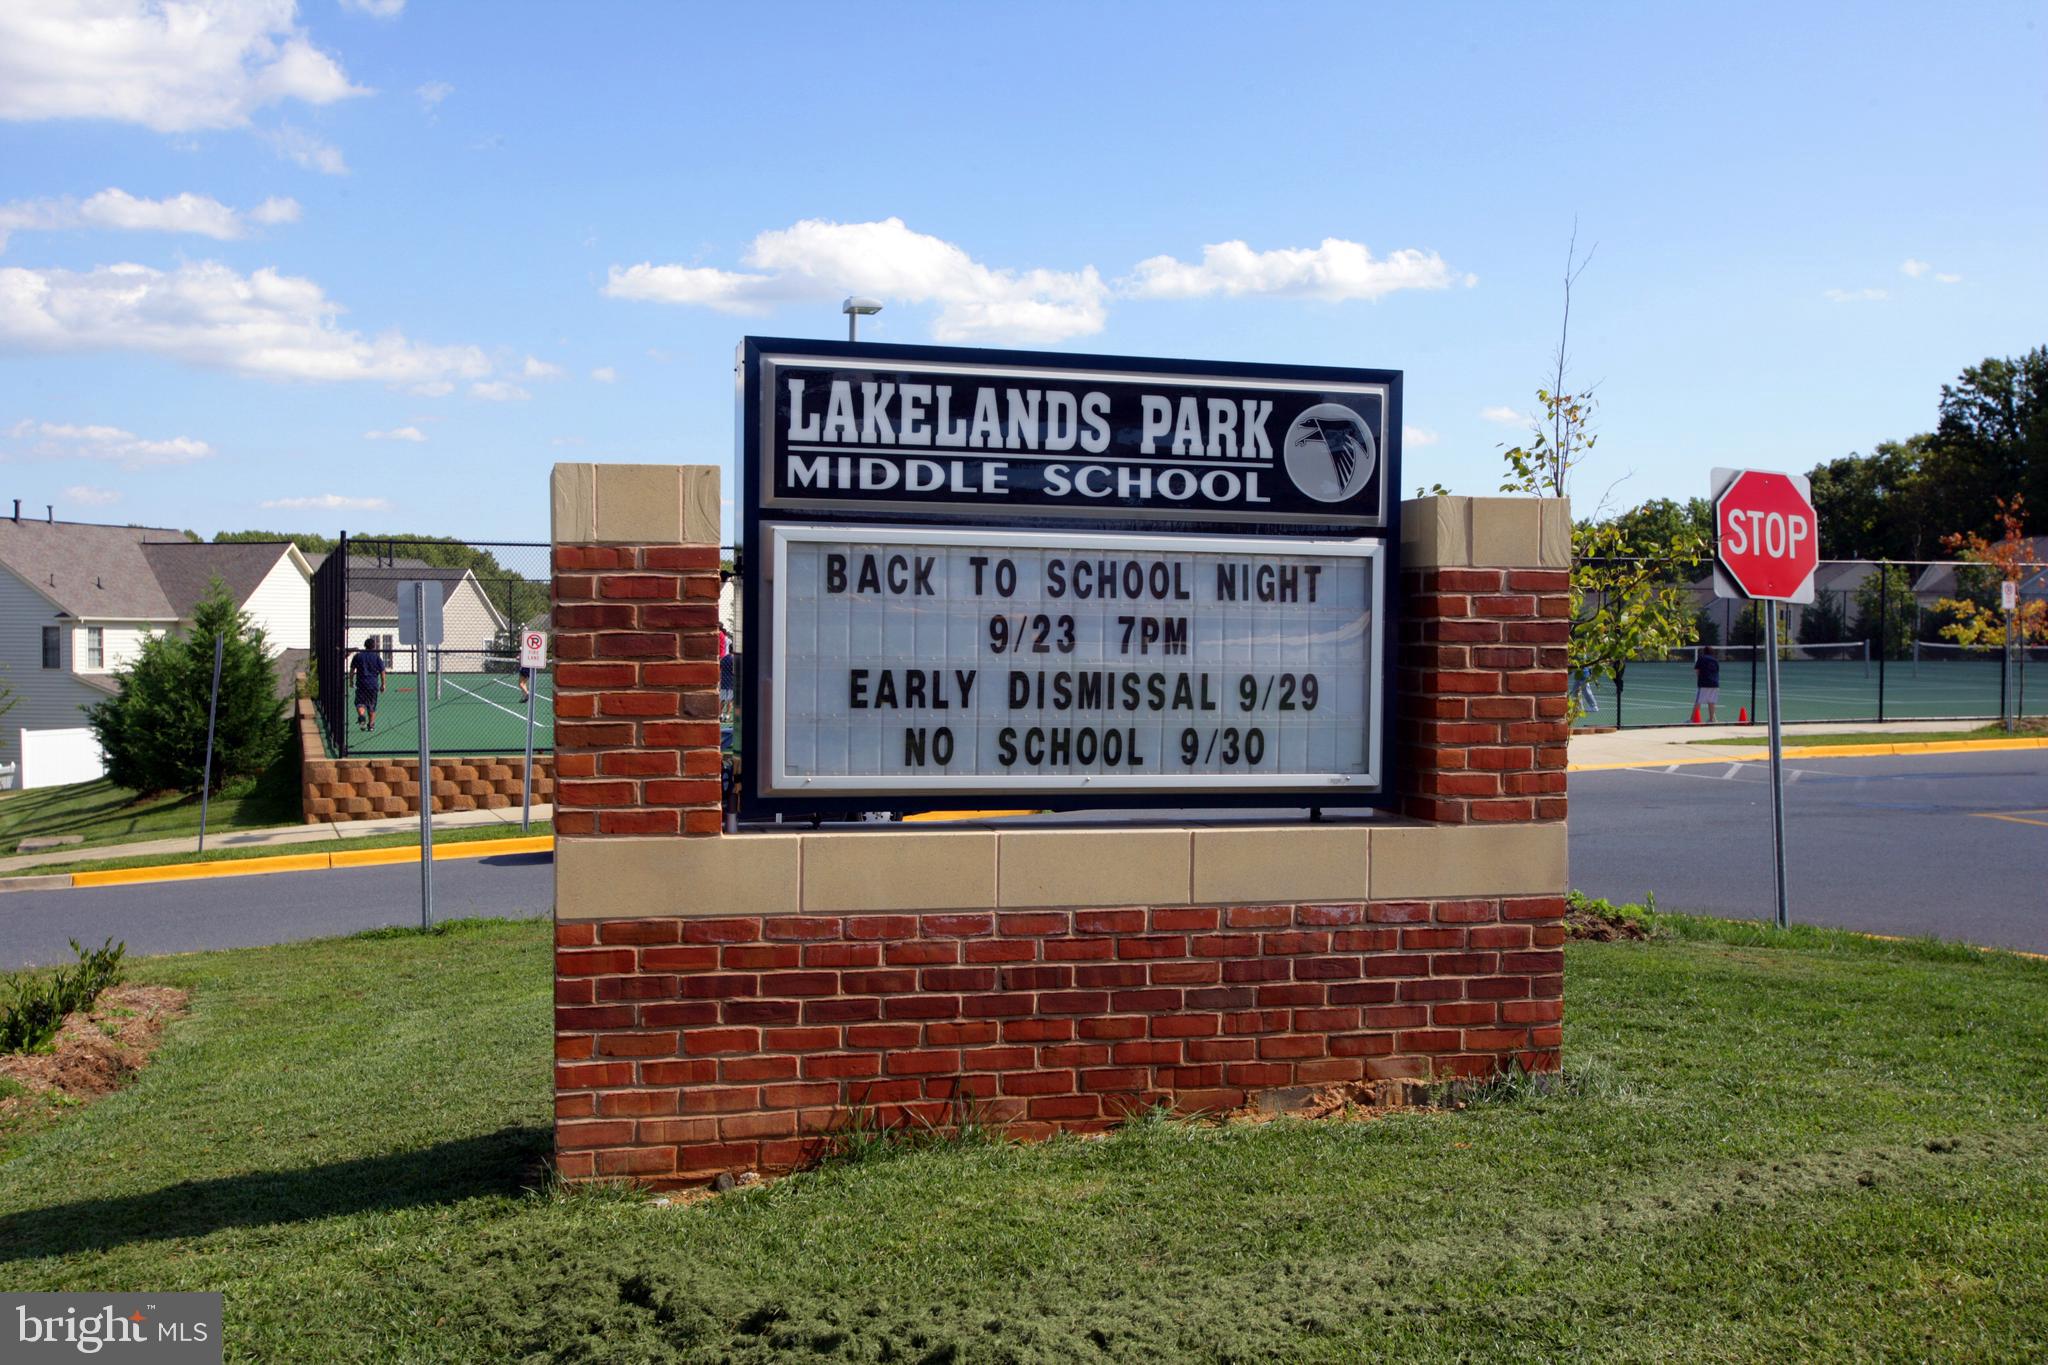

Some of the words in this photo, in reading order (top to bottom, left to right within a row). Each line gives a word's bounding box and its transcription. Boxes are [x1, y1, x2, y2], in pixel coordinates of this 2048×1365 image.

[788, 378, 1112, 454] LAKELANDS
[1141, 395, 1274, 460] PARK
[787, 455, 1010, 494] MIDDLE
[1043, 463, 1273, 503] SCHOOL
[1727, 508, 1808, 559] STOP
[826, 553, 935, 596] BACK
[969, 556, 1017, 598] TO
[1047, 558, 1190, 600] SCHOOL
[1216, 563, 1322, 603] NIGHT
[989, 614, 1076, 654] 9/23
[1117, 615, 1188, 655] 7PM
[849, 668, 977, 710] EARLY
[1007, 670, 1216, 712] DISMISSAL
[1239, 672, 1319, 713] 9/29
[904, 726, 954, 767] NO
[998, 726, 1144, 767] SCHOOL
[1180, 727, 1265, 767] 9/30
